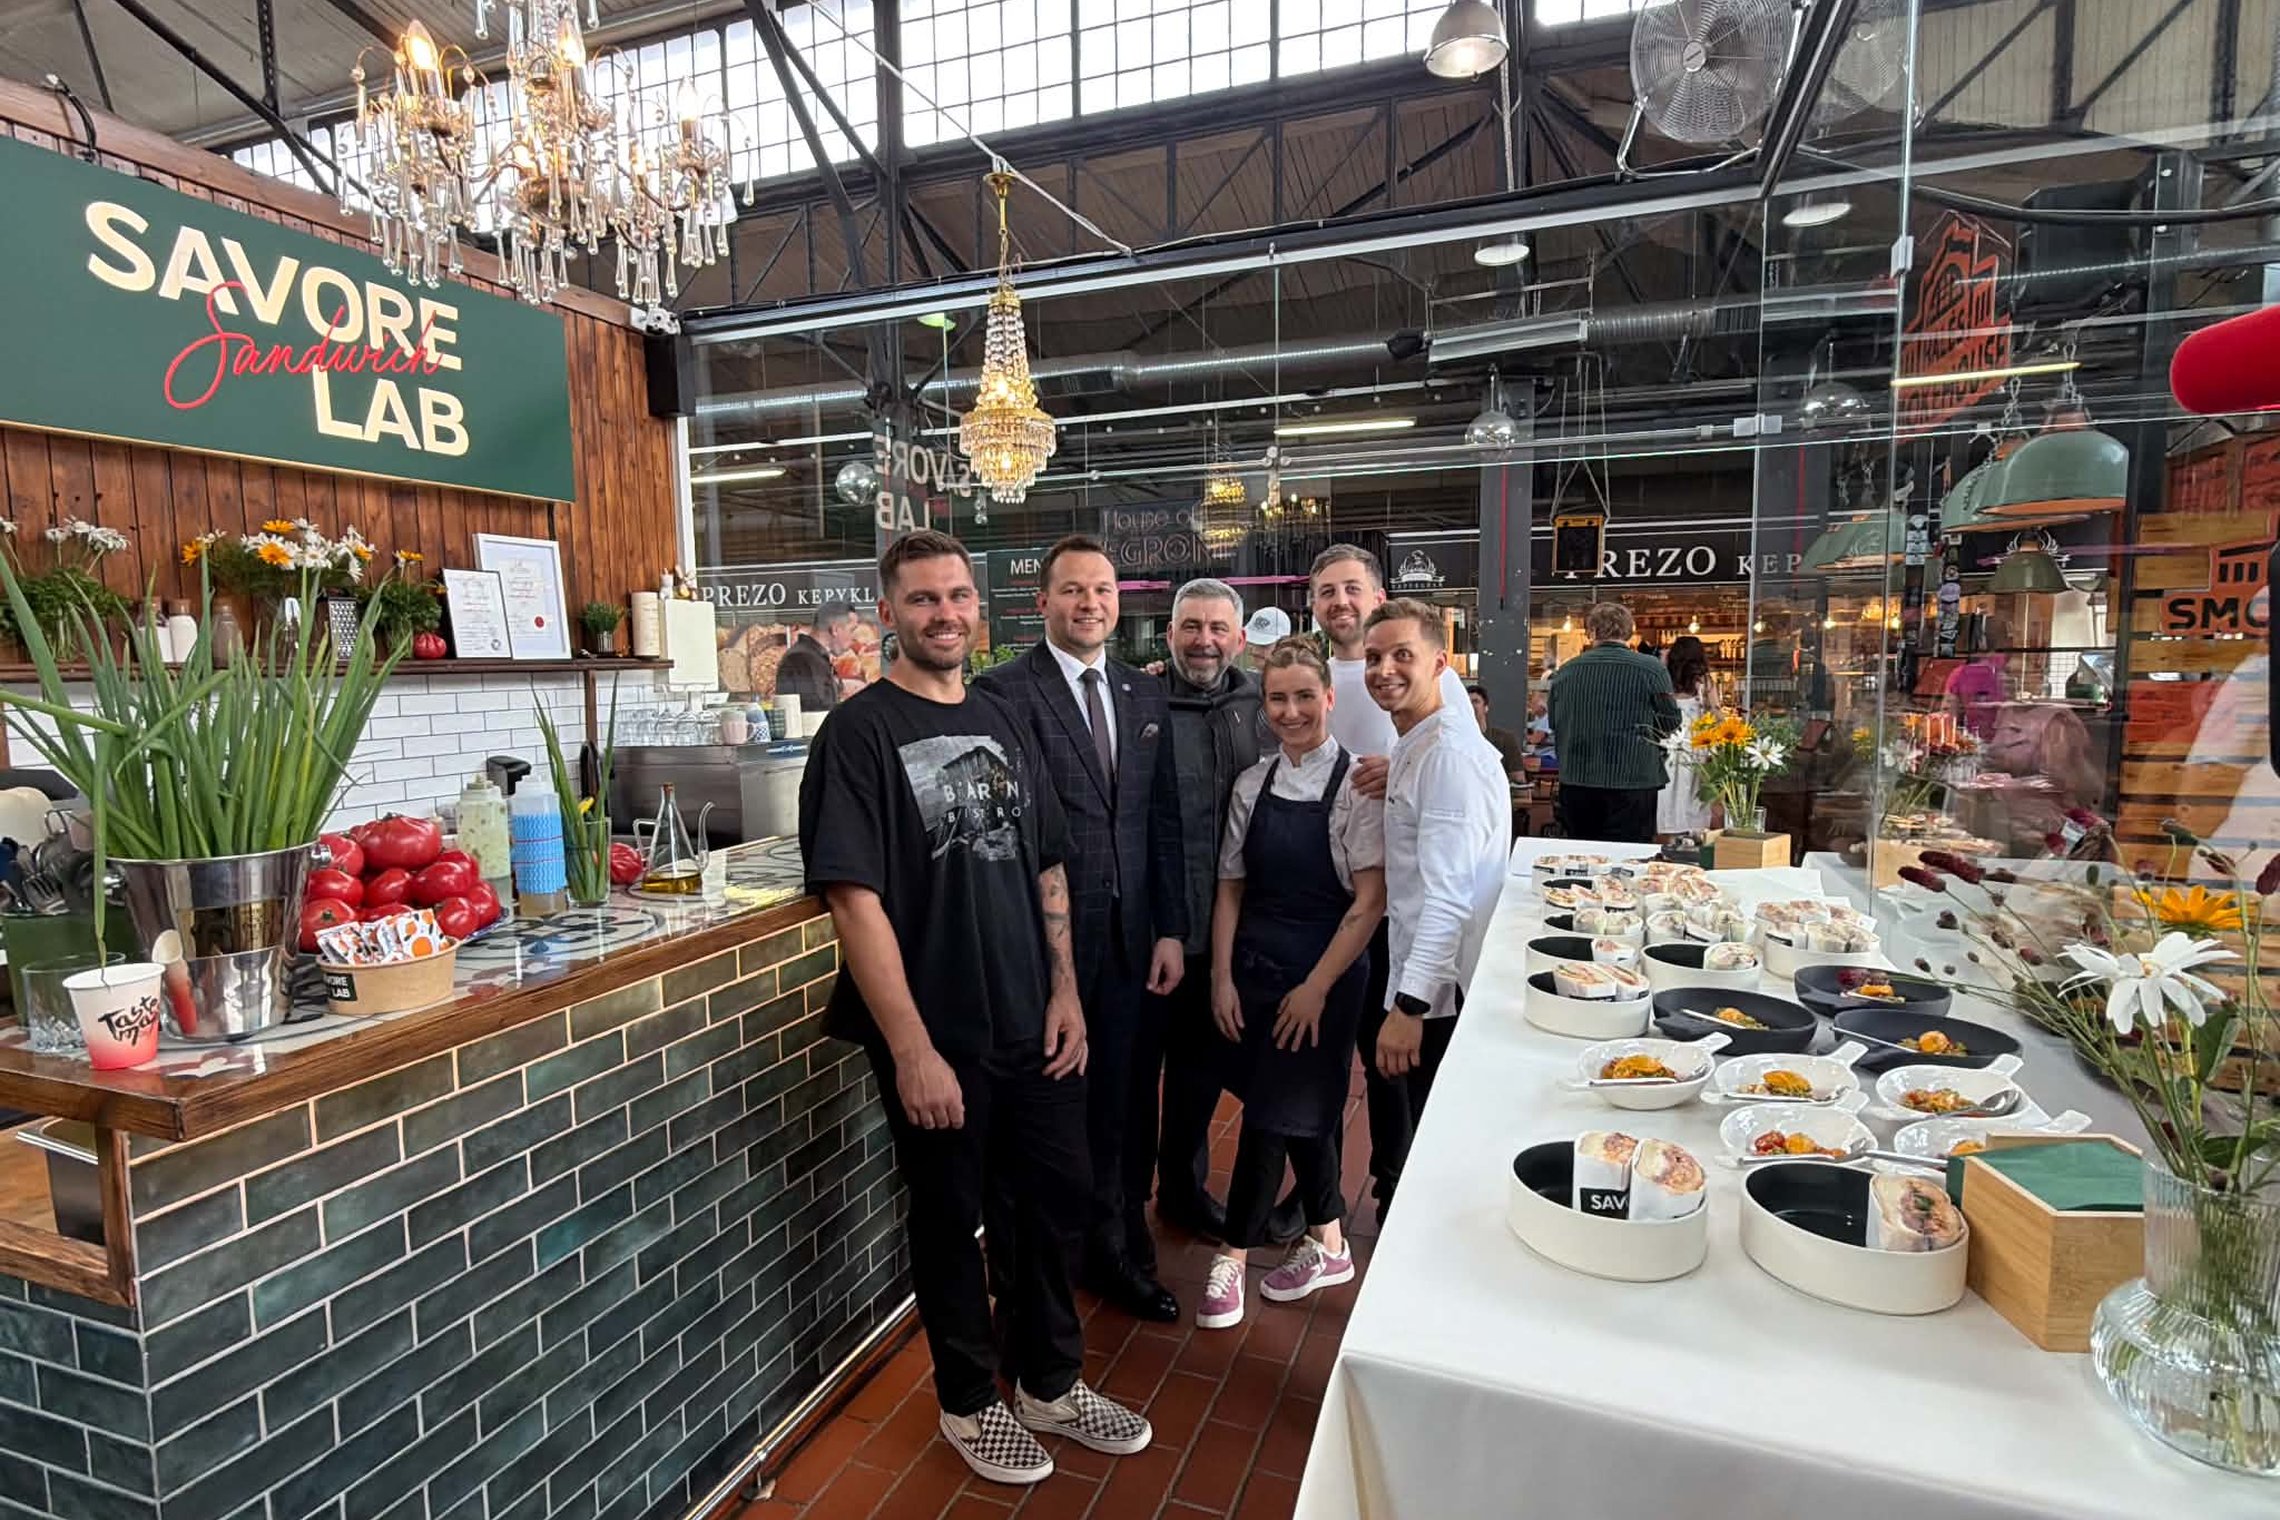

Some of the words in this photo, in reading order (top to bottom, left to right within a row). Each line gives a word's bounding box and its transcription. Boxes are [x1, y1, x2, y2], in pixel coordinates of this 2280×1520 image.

[84, 200, 462, 370] SAVORE
[163, 280, 445, 410] Sandwich
[311, 363, 470, 457] LAB
[1010, 558, 1041, 576] MEN
[1594, 546, 1717, 578] REZO
[702, 583, 786, 607] PREZO
[798, 587, 875, 605] KEPYKL
[2168, 597, 2270, 630] SMO
[1590, 1194, 1628, 1210] SAV
